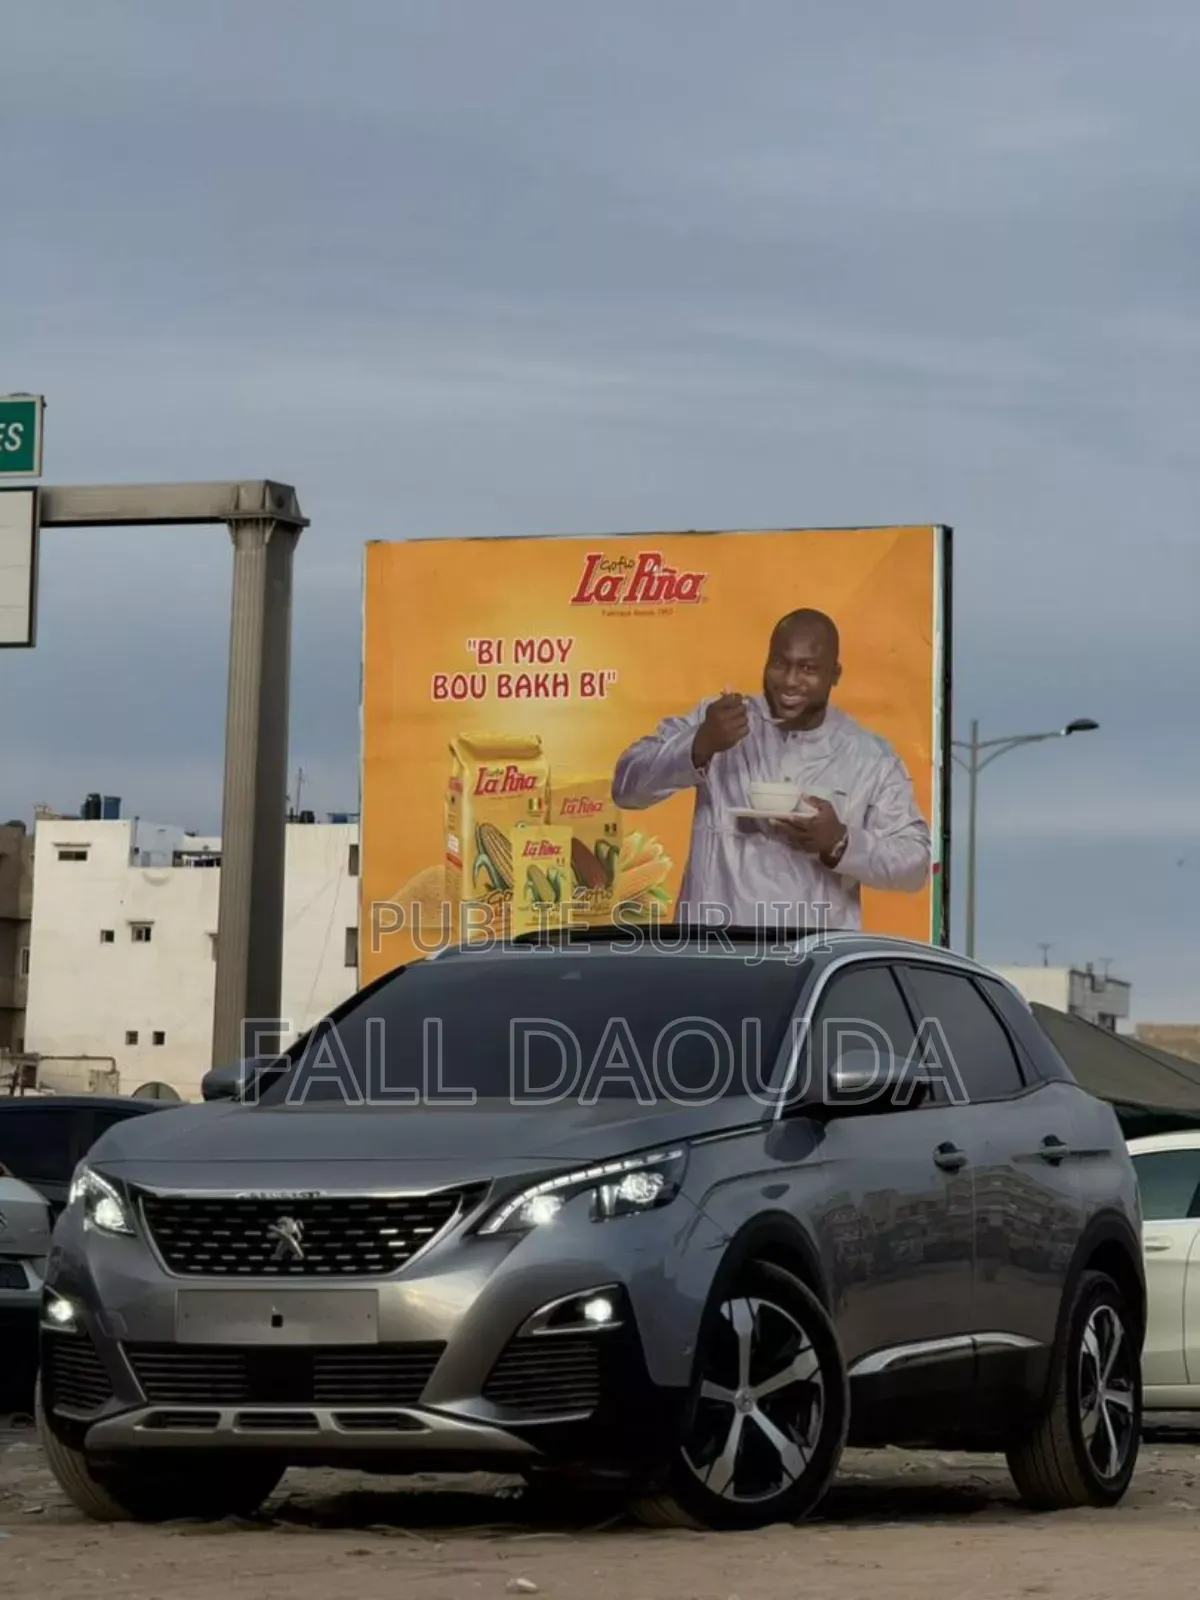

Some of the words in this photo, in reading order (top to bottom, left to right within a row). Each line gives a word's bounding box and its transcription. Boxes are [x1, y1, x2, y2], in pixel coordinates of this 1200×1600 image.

[0, 422, 24, 452] S
[568, 551, 625, 605] La
[620, 550, 708, 604] Piña
[513, 637, 574, 664] MOY
[433, 673, 487, 700] BOU
[497, 672, 570, 699] BAKH
